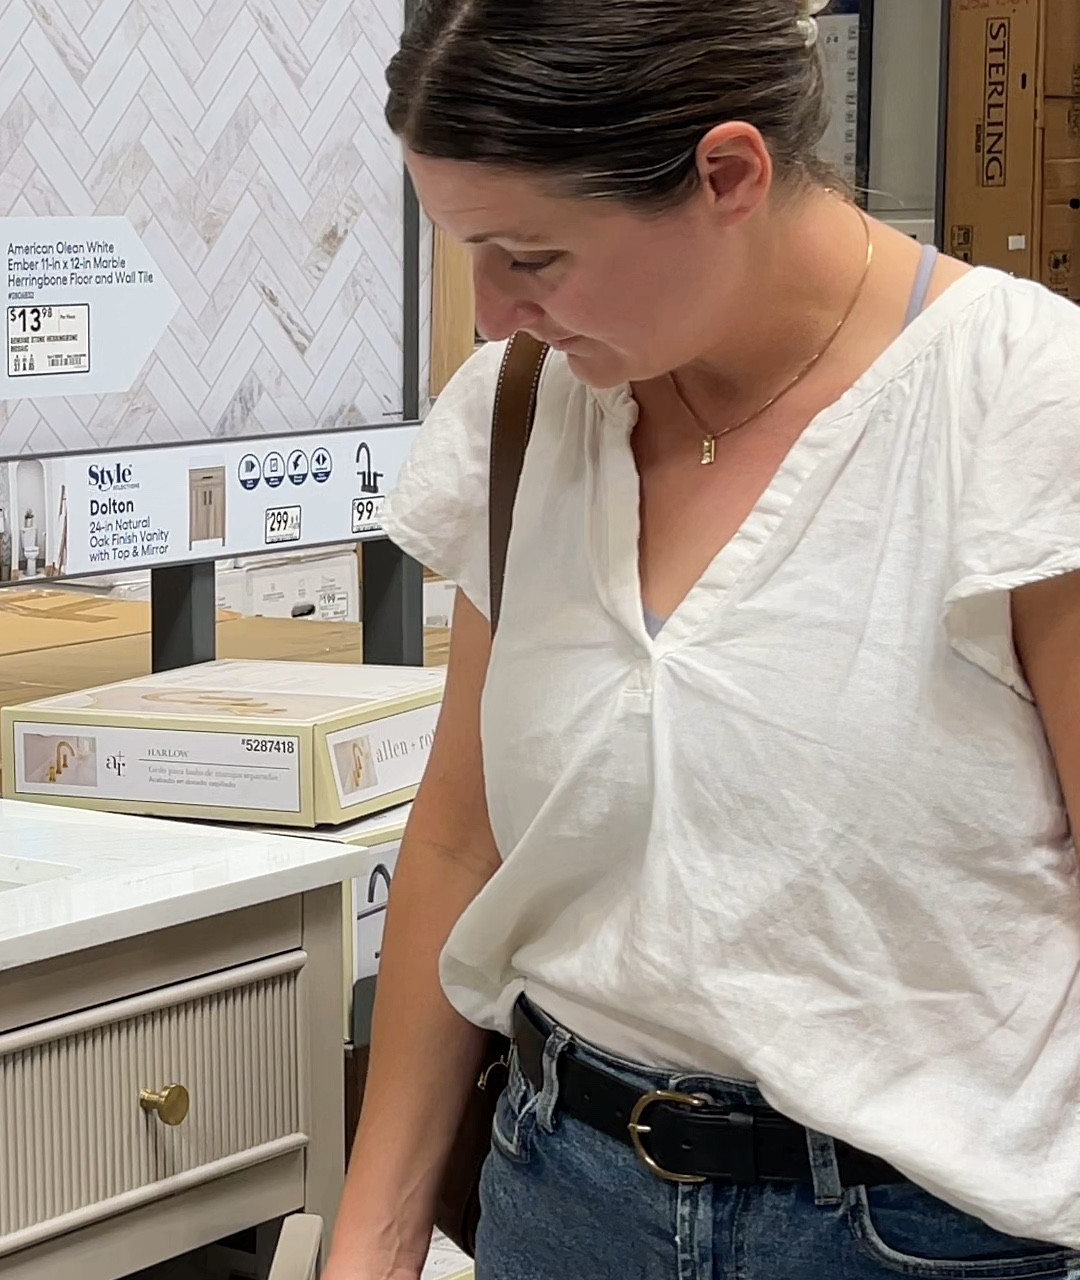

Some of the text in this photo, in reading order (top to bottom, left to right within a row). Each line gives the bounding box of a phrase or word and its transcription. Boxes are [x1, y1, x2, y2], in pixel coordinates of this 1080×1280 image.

[984, 21, 1007, 183] STERLING
[8, 241, 114, 255] American Olean White
[8, 257, 126, 271] Ember 11-in x 12-in Marble
[8, 271, 153, 289] Herringbone Floor and Wall Tile
[88, 463, 131, 492] Style
[90, 498, 134, 516] Dolton
[90, 516, 150, 533] 24-in Natural
[90, 529, 169, 548] Oak Finish Vanity
[90, 544, 168, 562] with Top & Mirror
[147, 748, 189, 758] HARLOW
[241, 738, 295, 754] #5287418
[376, 739, 408, 763] allen
